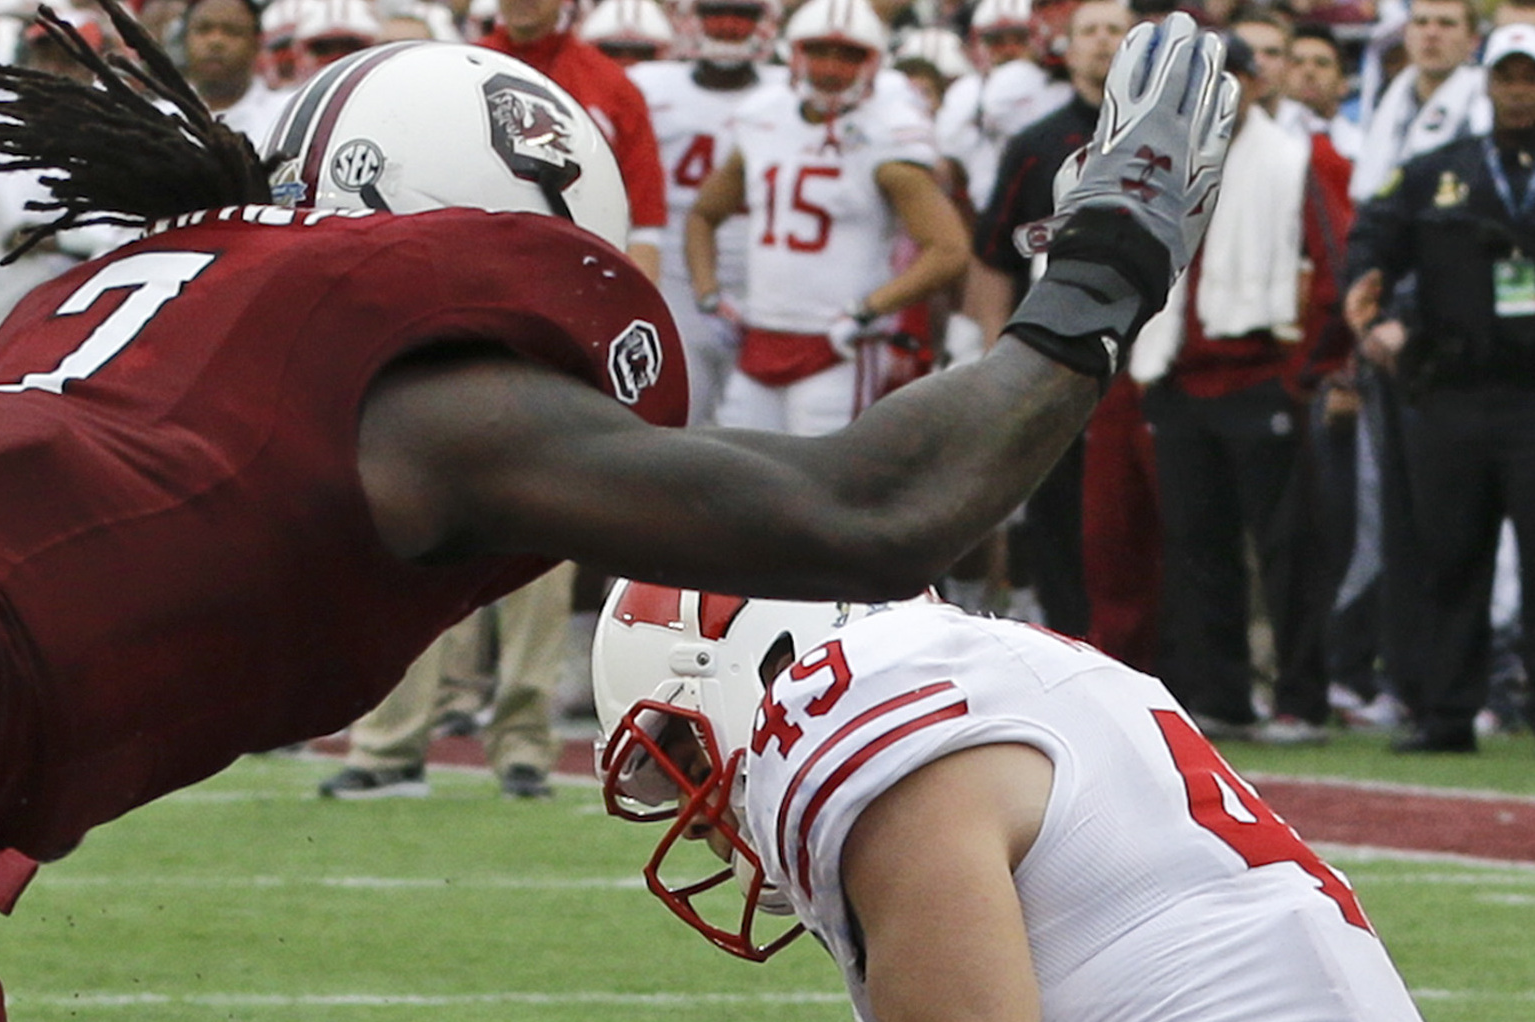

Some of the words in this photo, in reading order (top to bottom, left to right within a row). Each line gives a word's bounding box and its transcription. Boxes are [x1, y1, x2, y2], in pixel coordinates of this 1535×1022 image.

[335, 144, 379, 187] SEC
[762, 164, 841, 252] 15
[751, 638, 853, 761] 49
